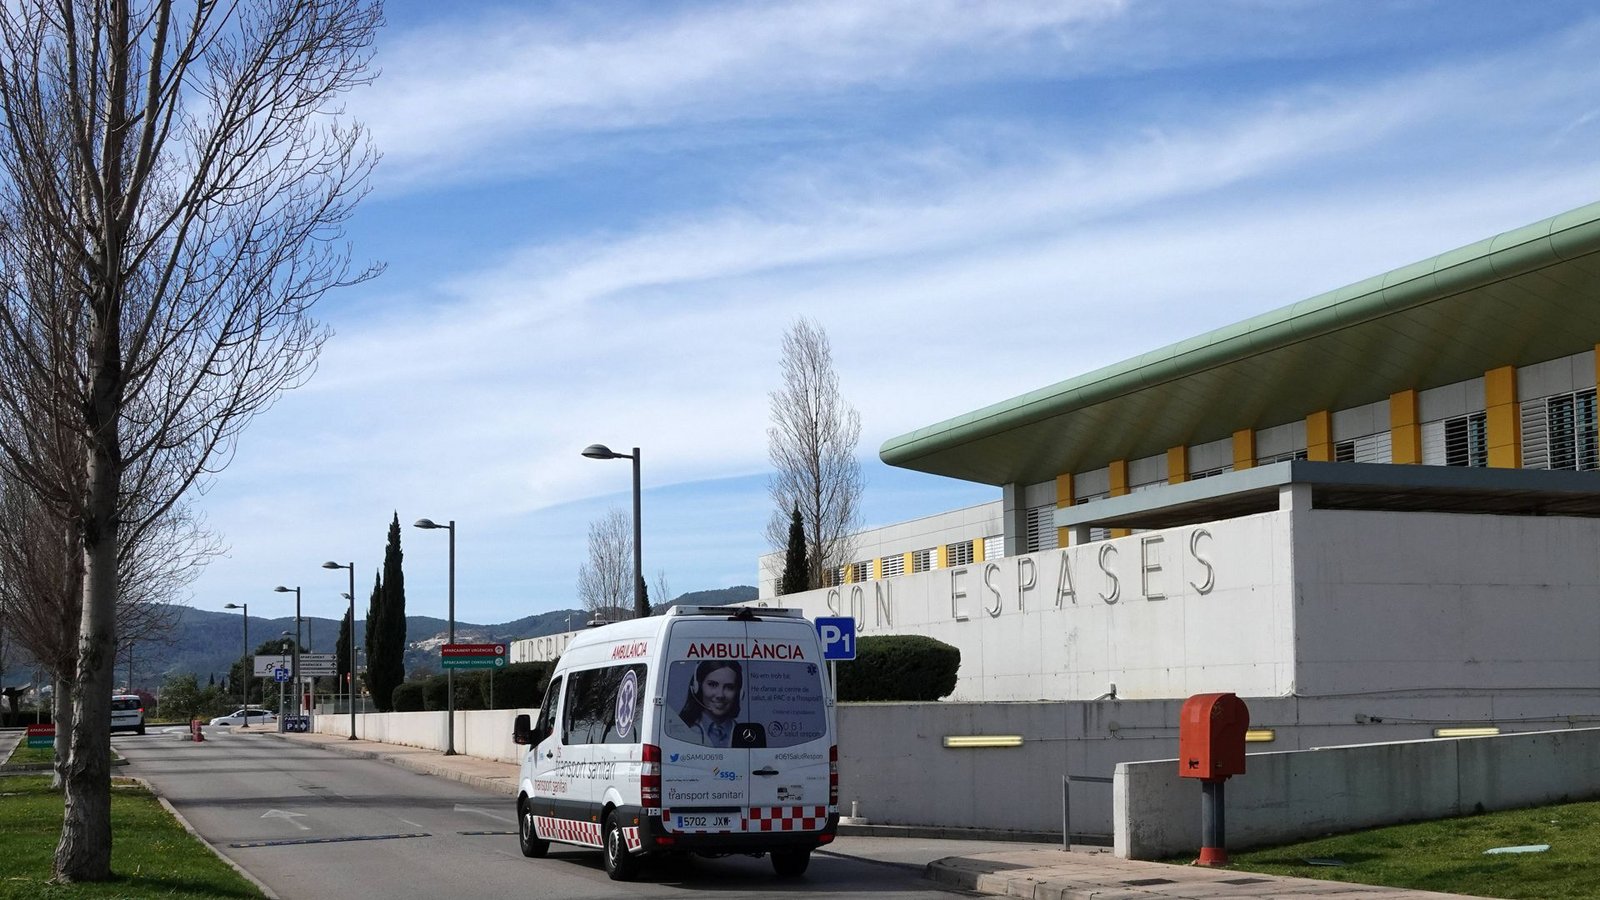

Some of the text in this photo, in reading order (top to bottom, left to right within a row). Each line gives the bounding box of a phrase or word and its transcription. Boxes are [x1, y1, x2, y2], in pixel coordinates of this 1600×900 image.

[827, 528, 1215, 633] SON ESPASES
[519, 633, 577, 662] HOSPIT
[611, 640, 648, 660] AMBULÀNCIA
[687, 639, 804, 660] AMBULÀNCIA
[668, 790, 744, 802] transport sanitari
[683, 817, 707, 827] 5702
